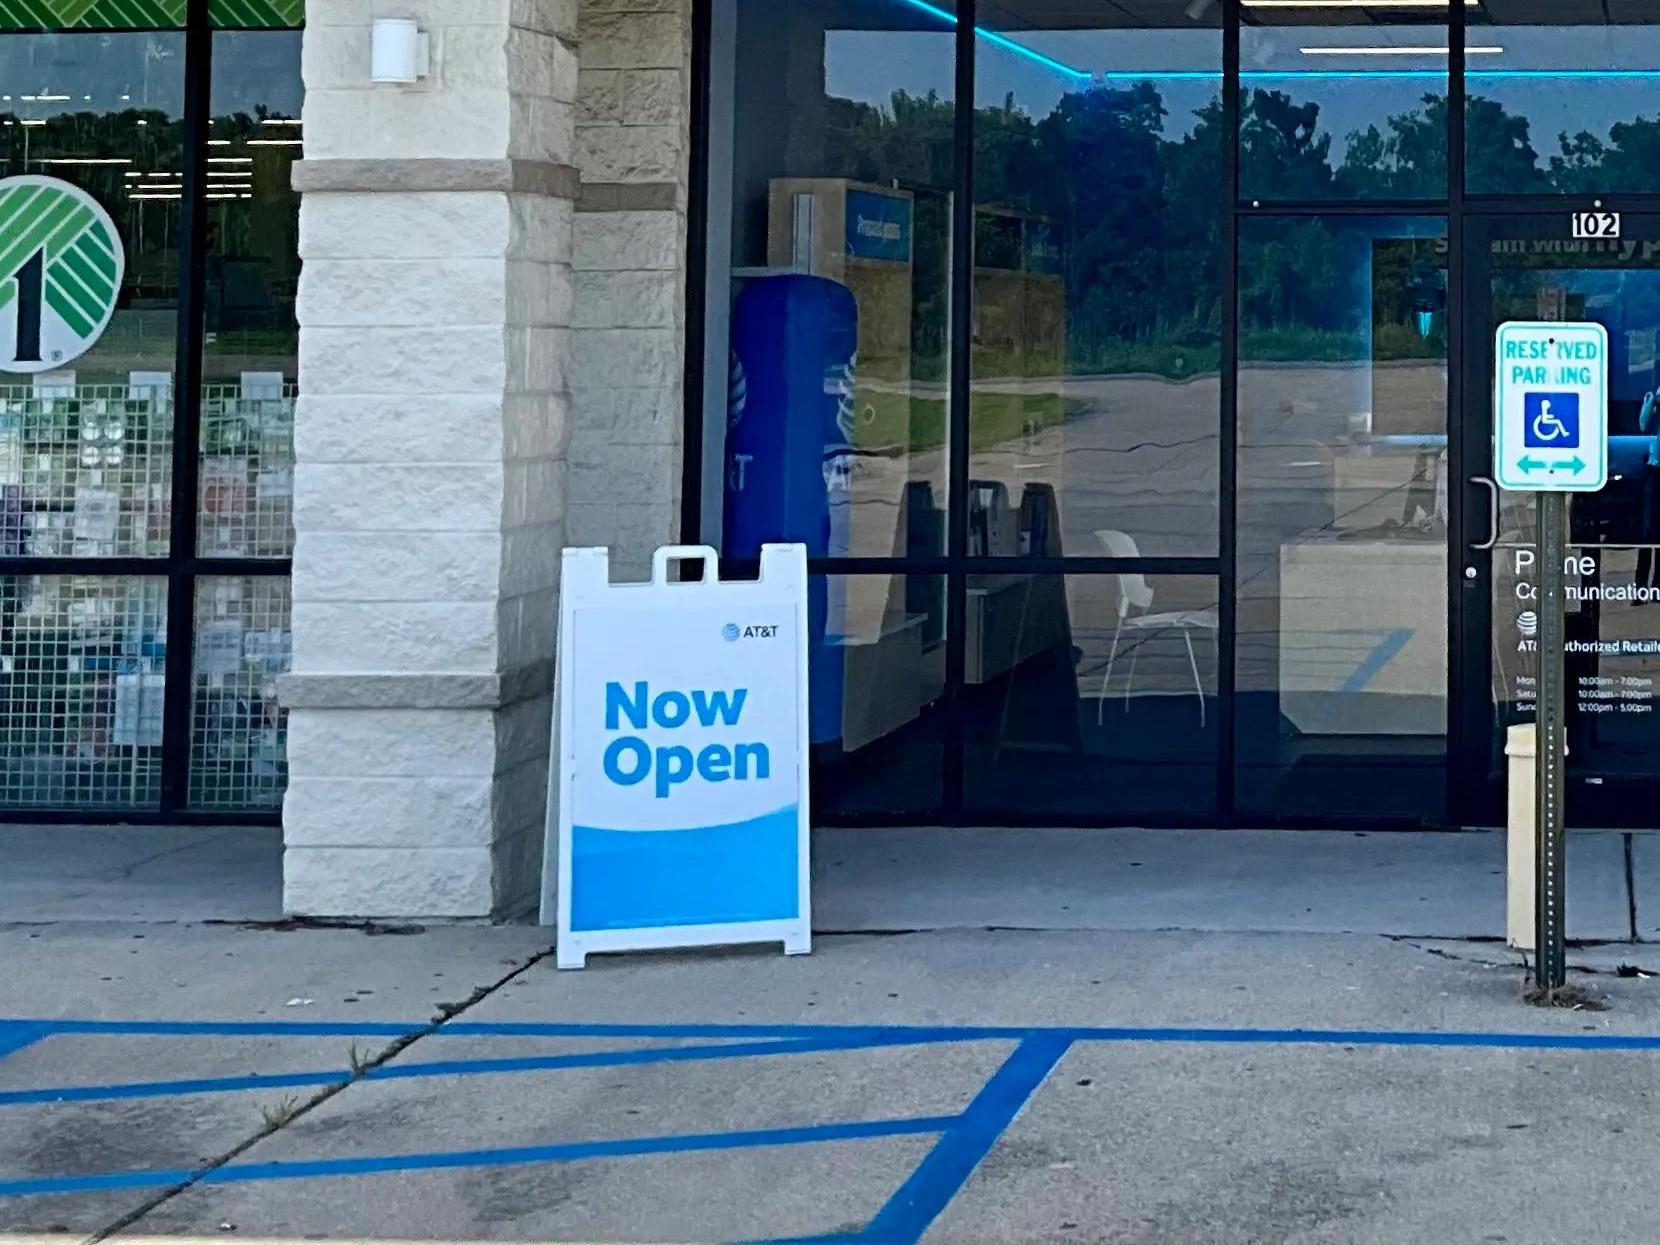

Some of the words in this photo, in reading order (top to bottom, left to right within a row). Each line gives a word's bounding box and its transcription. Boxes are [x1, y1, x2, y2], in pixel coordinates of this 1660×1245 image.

[1574, 213, 1617, 236] 102
[1512, 365, 1592, 385] PARING
[1515, 550, 1596, 575] Pne
[743, 625, 779, 638] AT&T
[1563, 639, 1620, 653] thorized
[605, 680, 748, 731] Now
[603, 735, 770, 799] Open
